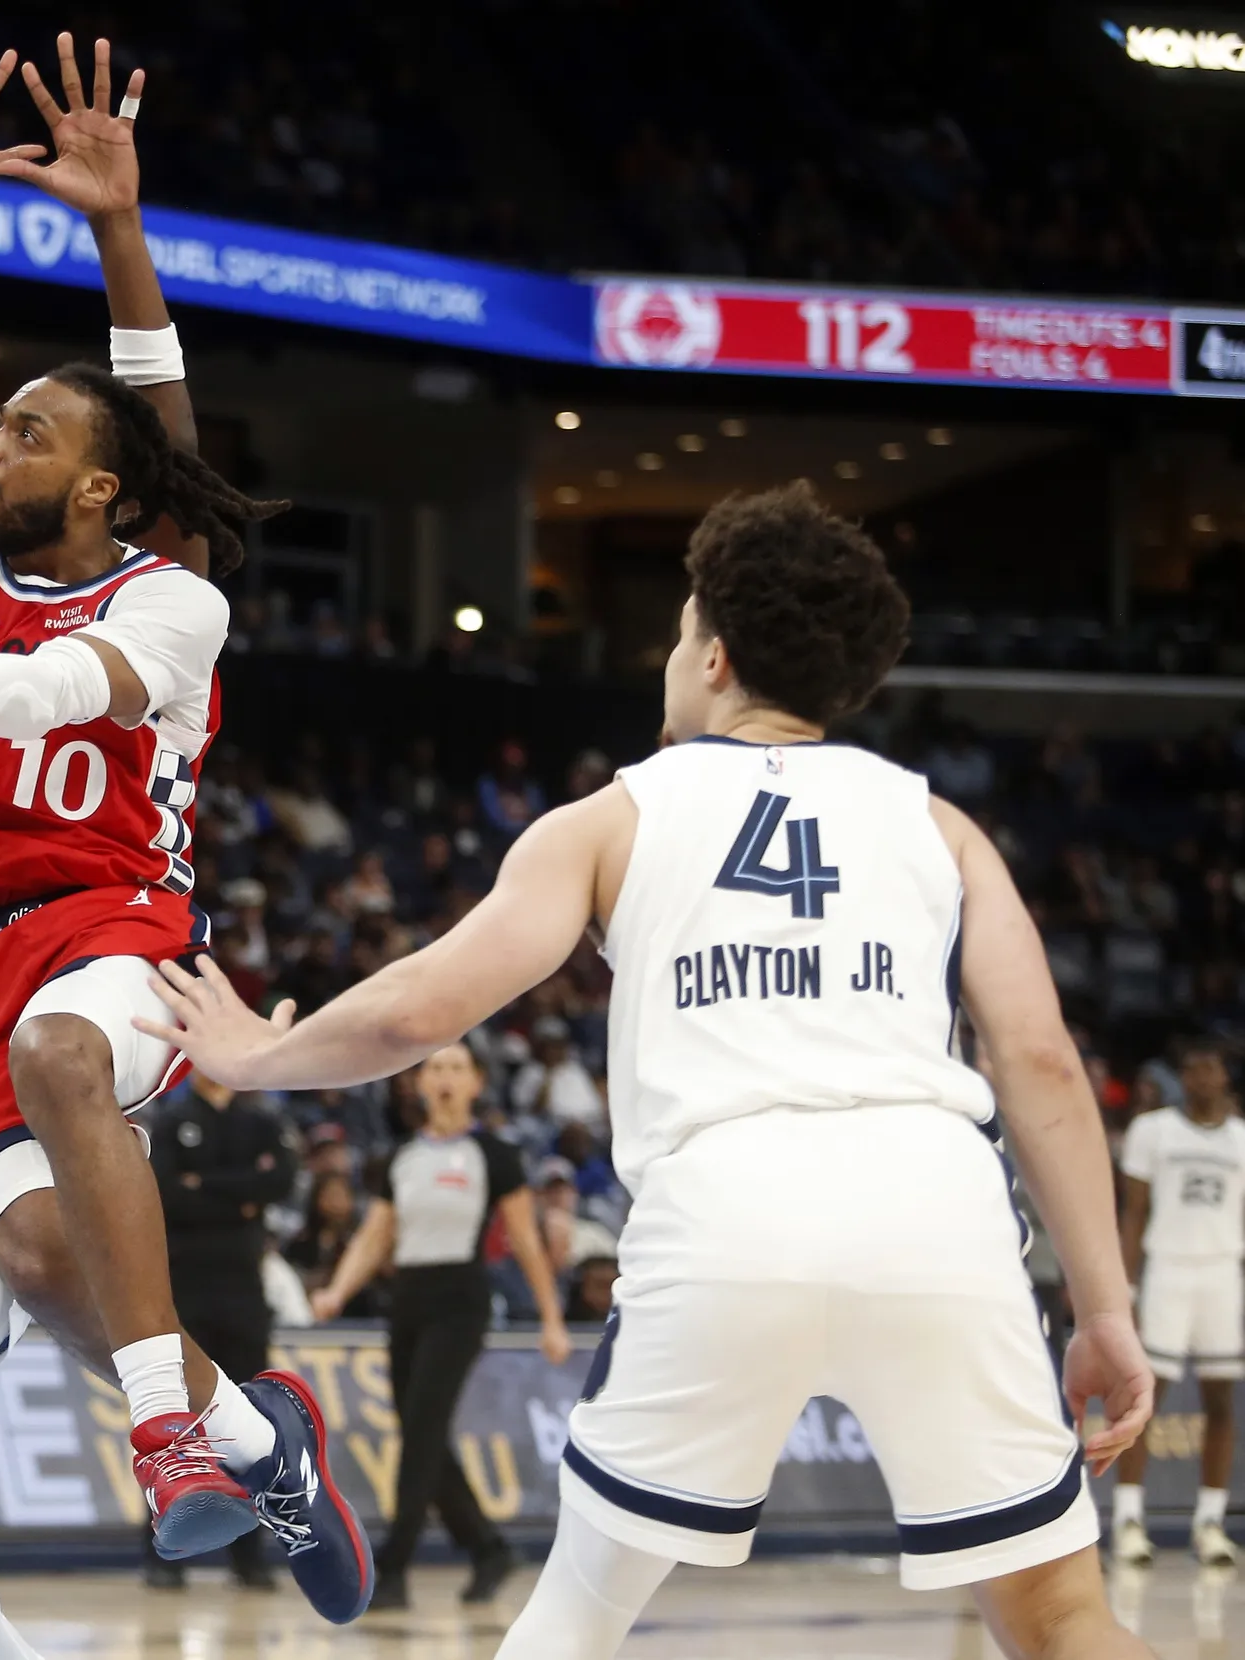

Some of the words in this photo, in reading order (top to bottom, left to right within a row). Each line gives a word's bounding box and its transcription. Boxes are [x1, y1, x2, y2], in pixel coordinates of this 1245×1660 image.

[797, 299, 915, 374] 112
[969, 340, 1079, 382] FOULS
[44, 614, 90, 629] RWANDA
[59, 604, 84, 619] VISIT
[10, 738, 108, 821] 10
[712, 788, 840, 920] 4
[674, 944, 822, 1011] CLAYTON
[849, 940, 905, 1001] JR.
